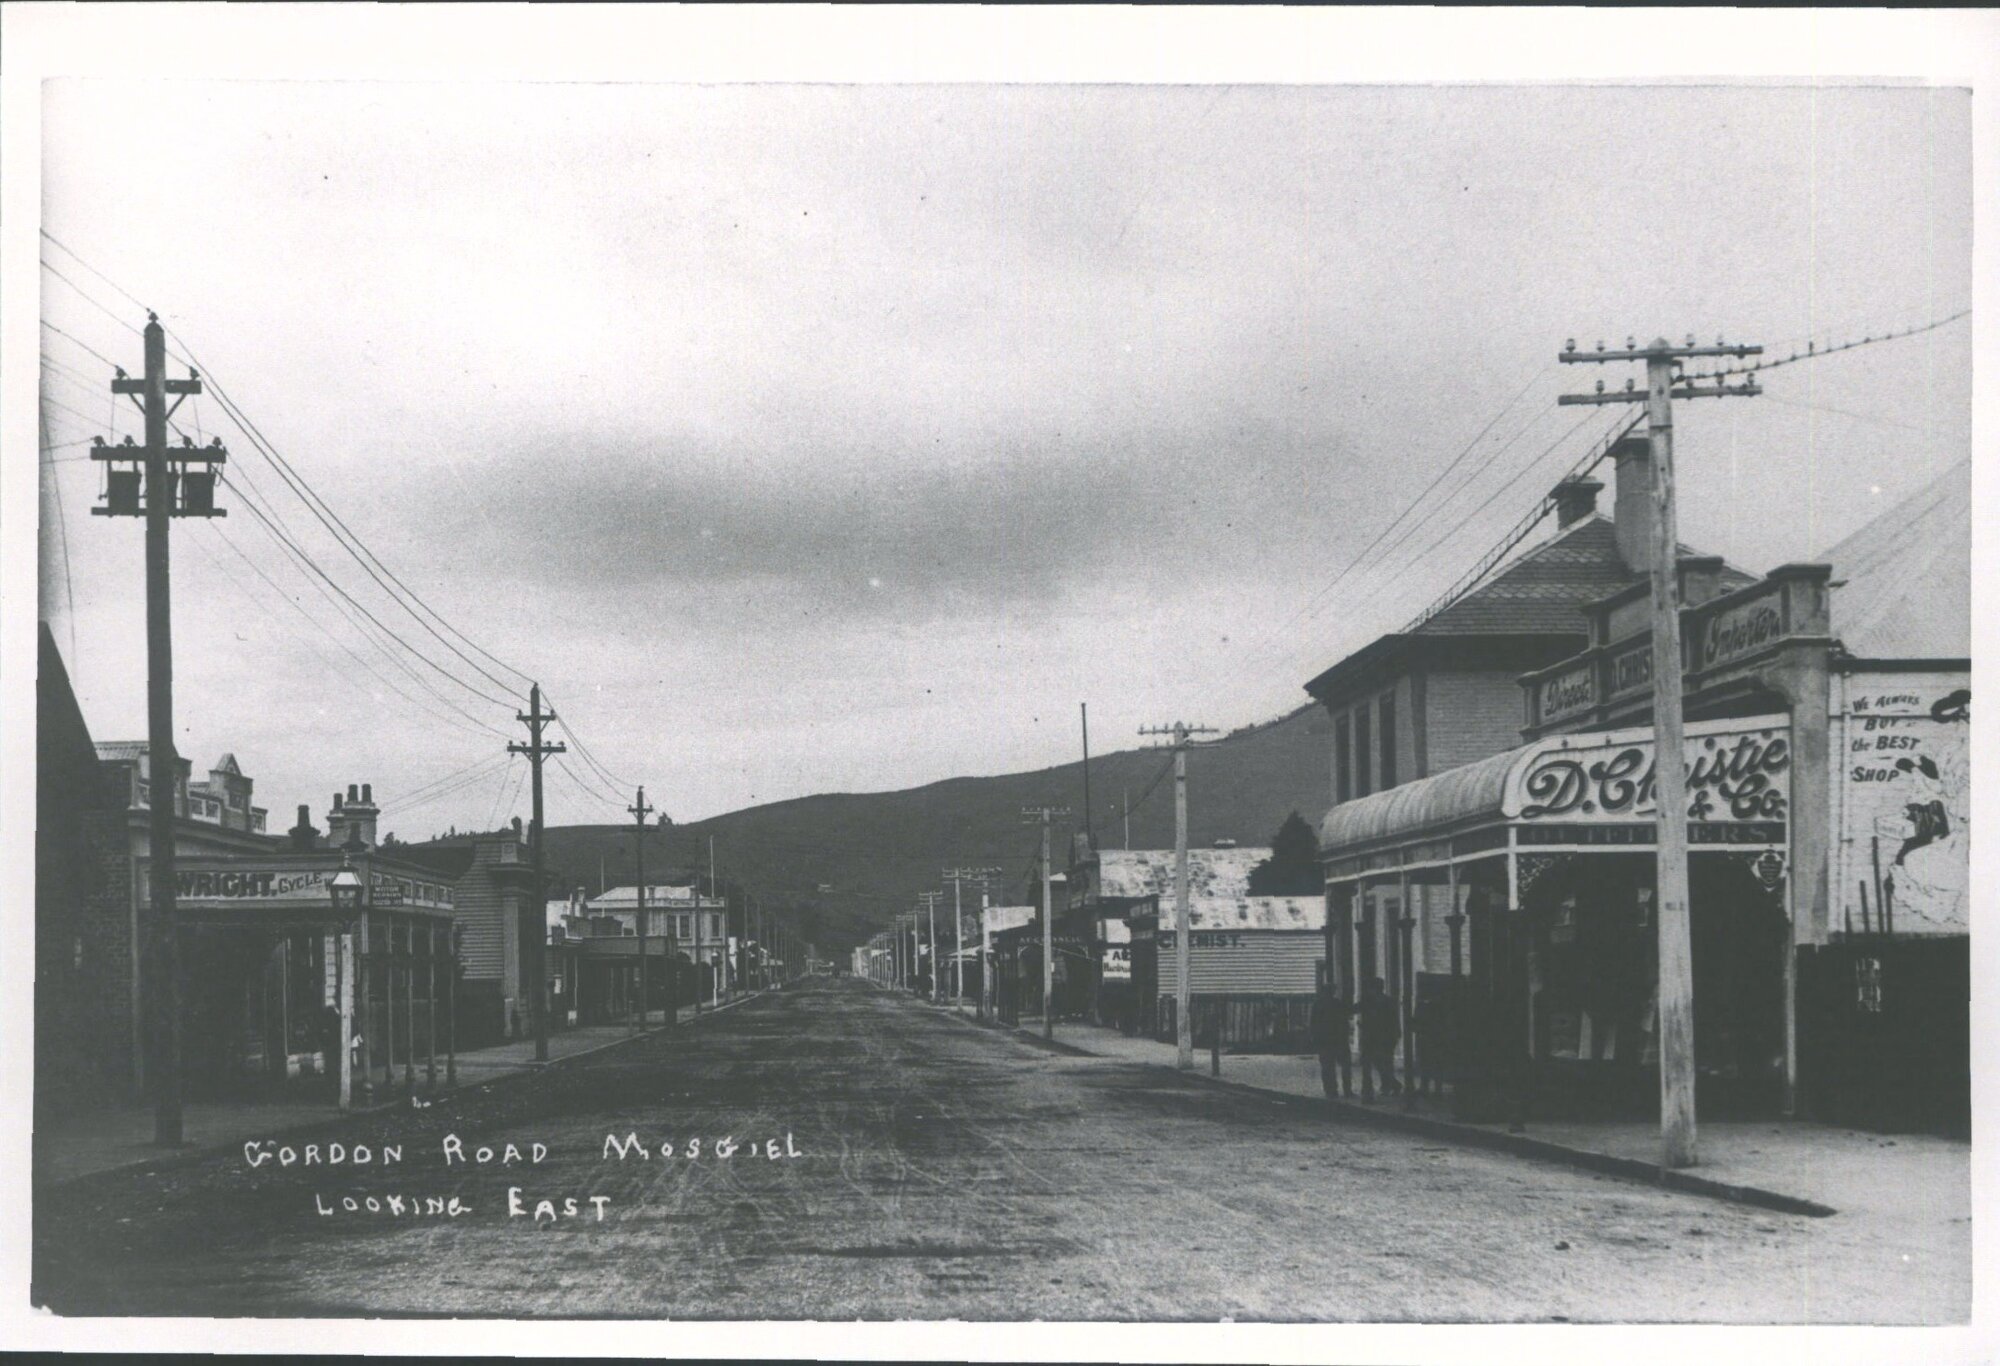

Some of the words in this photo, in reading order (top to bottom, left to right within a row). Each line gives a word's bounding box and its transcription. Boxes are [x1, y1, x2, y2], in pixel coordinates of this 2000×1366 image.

[1864, 718, 1900, 731] BUY
[1851, 738, 1871, 752] the
[1876, 736, 1921, 751] BEST
[1852, 766, 1899, 782] SHOP
[1688, 790, 1713, 821] &
[1719, 773, 1787, 820] Co.
[278, 872, 323, 894] CYCLE
